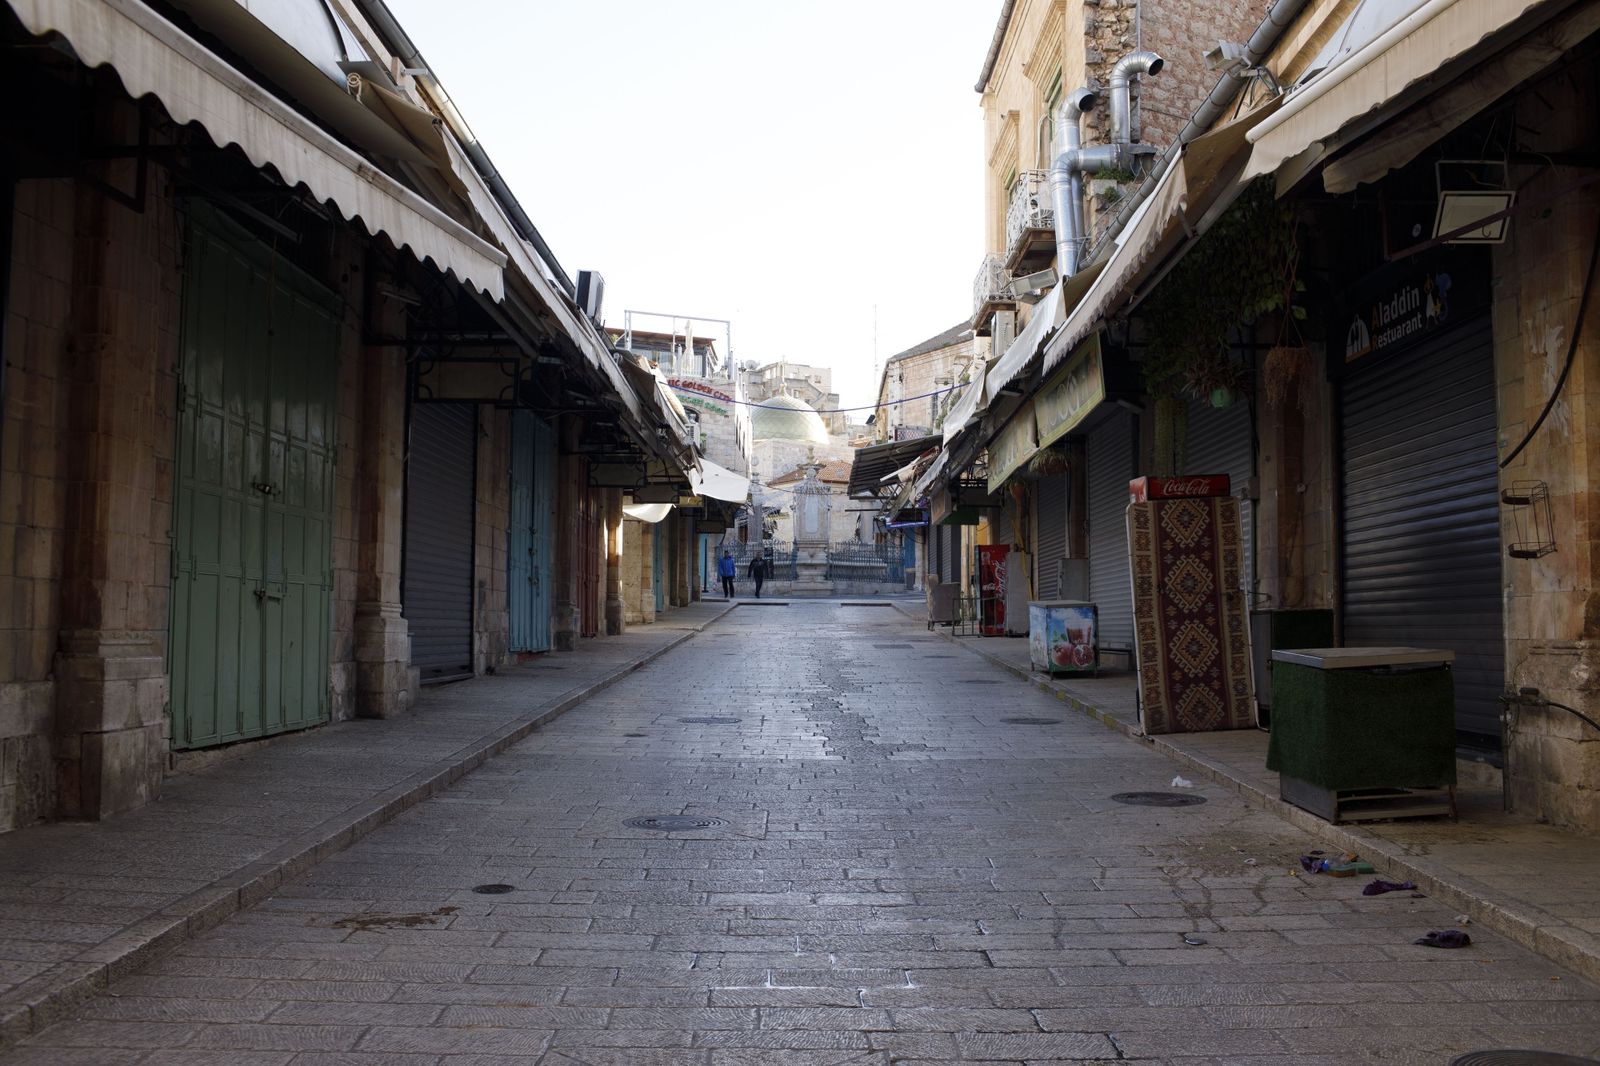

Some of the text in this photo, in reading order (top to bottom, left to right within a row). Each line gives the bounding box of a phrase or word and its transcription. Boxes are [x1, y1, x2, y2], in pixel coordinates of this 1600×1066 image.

[1372, 285, 1420, 330] Aladdin
[1371, 311, 1423, 350] Restuarant
[682, 380, 712, 394] GOLDEN
[1163, 478, 1211, 496] Coca-Cola
